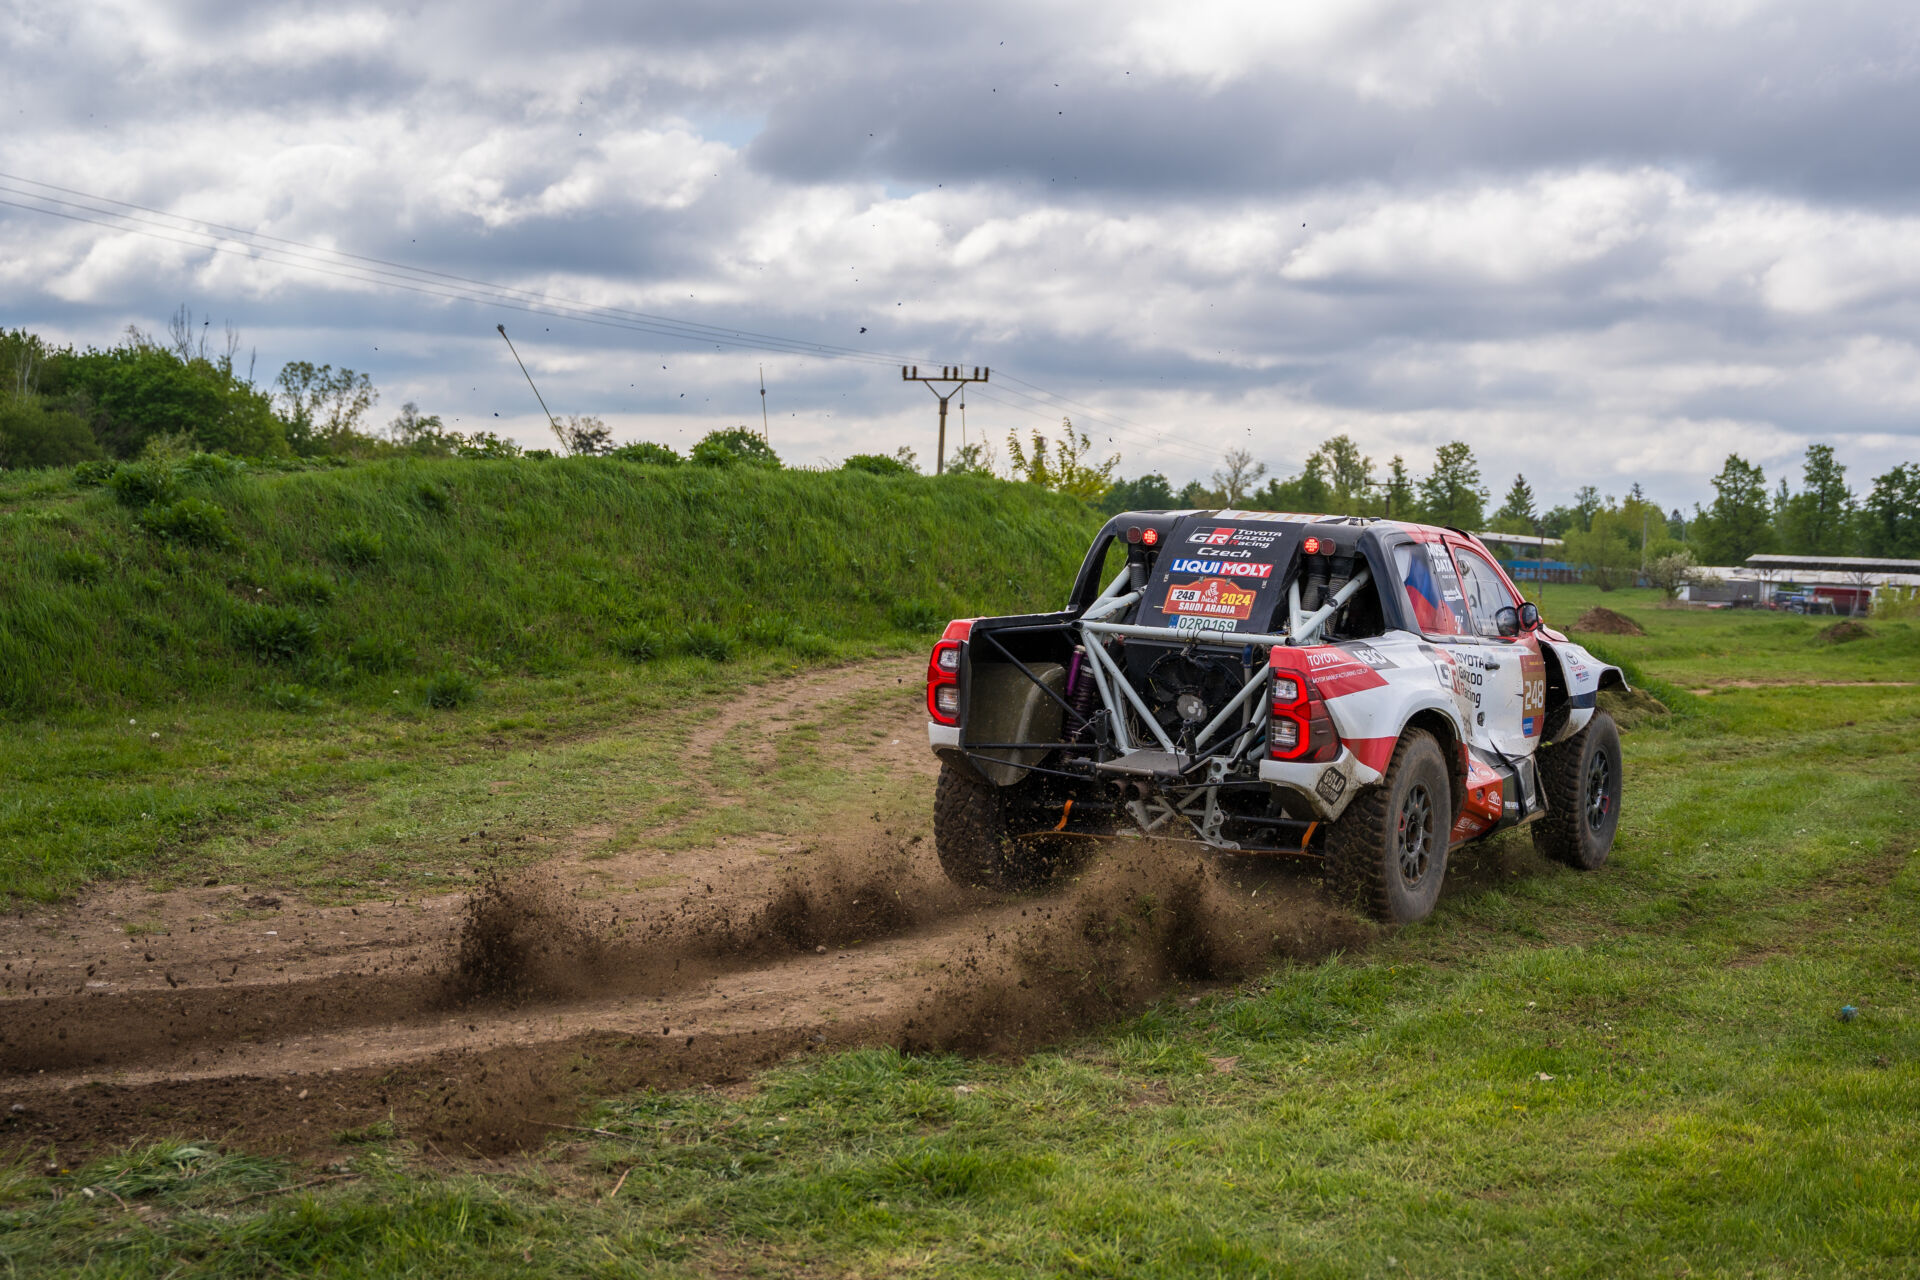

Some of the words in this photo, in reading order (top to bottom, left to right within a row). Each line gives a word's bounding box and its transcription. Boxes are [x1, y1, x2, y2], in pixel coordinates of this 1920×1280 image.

[1189, 533, 1228, 544] GR
[1232, 534, 1275, 542] GAZOO
[1238, 529, 1282, 537] TOYOTA
[1228, 540, 1270, 548] Racing
[1197, 547, 1252, 558] Czech
[1172, 560, 1221, 574] LIQUI
[1220, 563, 1271, 576] MOLY
[1176, 591, 1195, 601] 248
[1220, 593, 1252, 606] 2024
[1178, 602, 1204, 612] SAUDI
[1204, 604, 1236, 614] ARABIA
[1308, 653, 1340, 667] TOYOTA
[1525, 680, 1544, 710] 248
